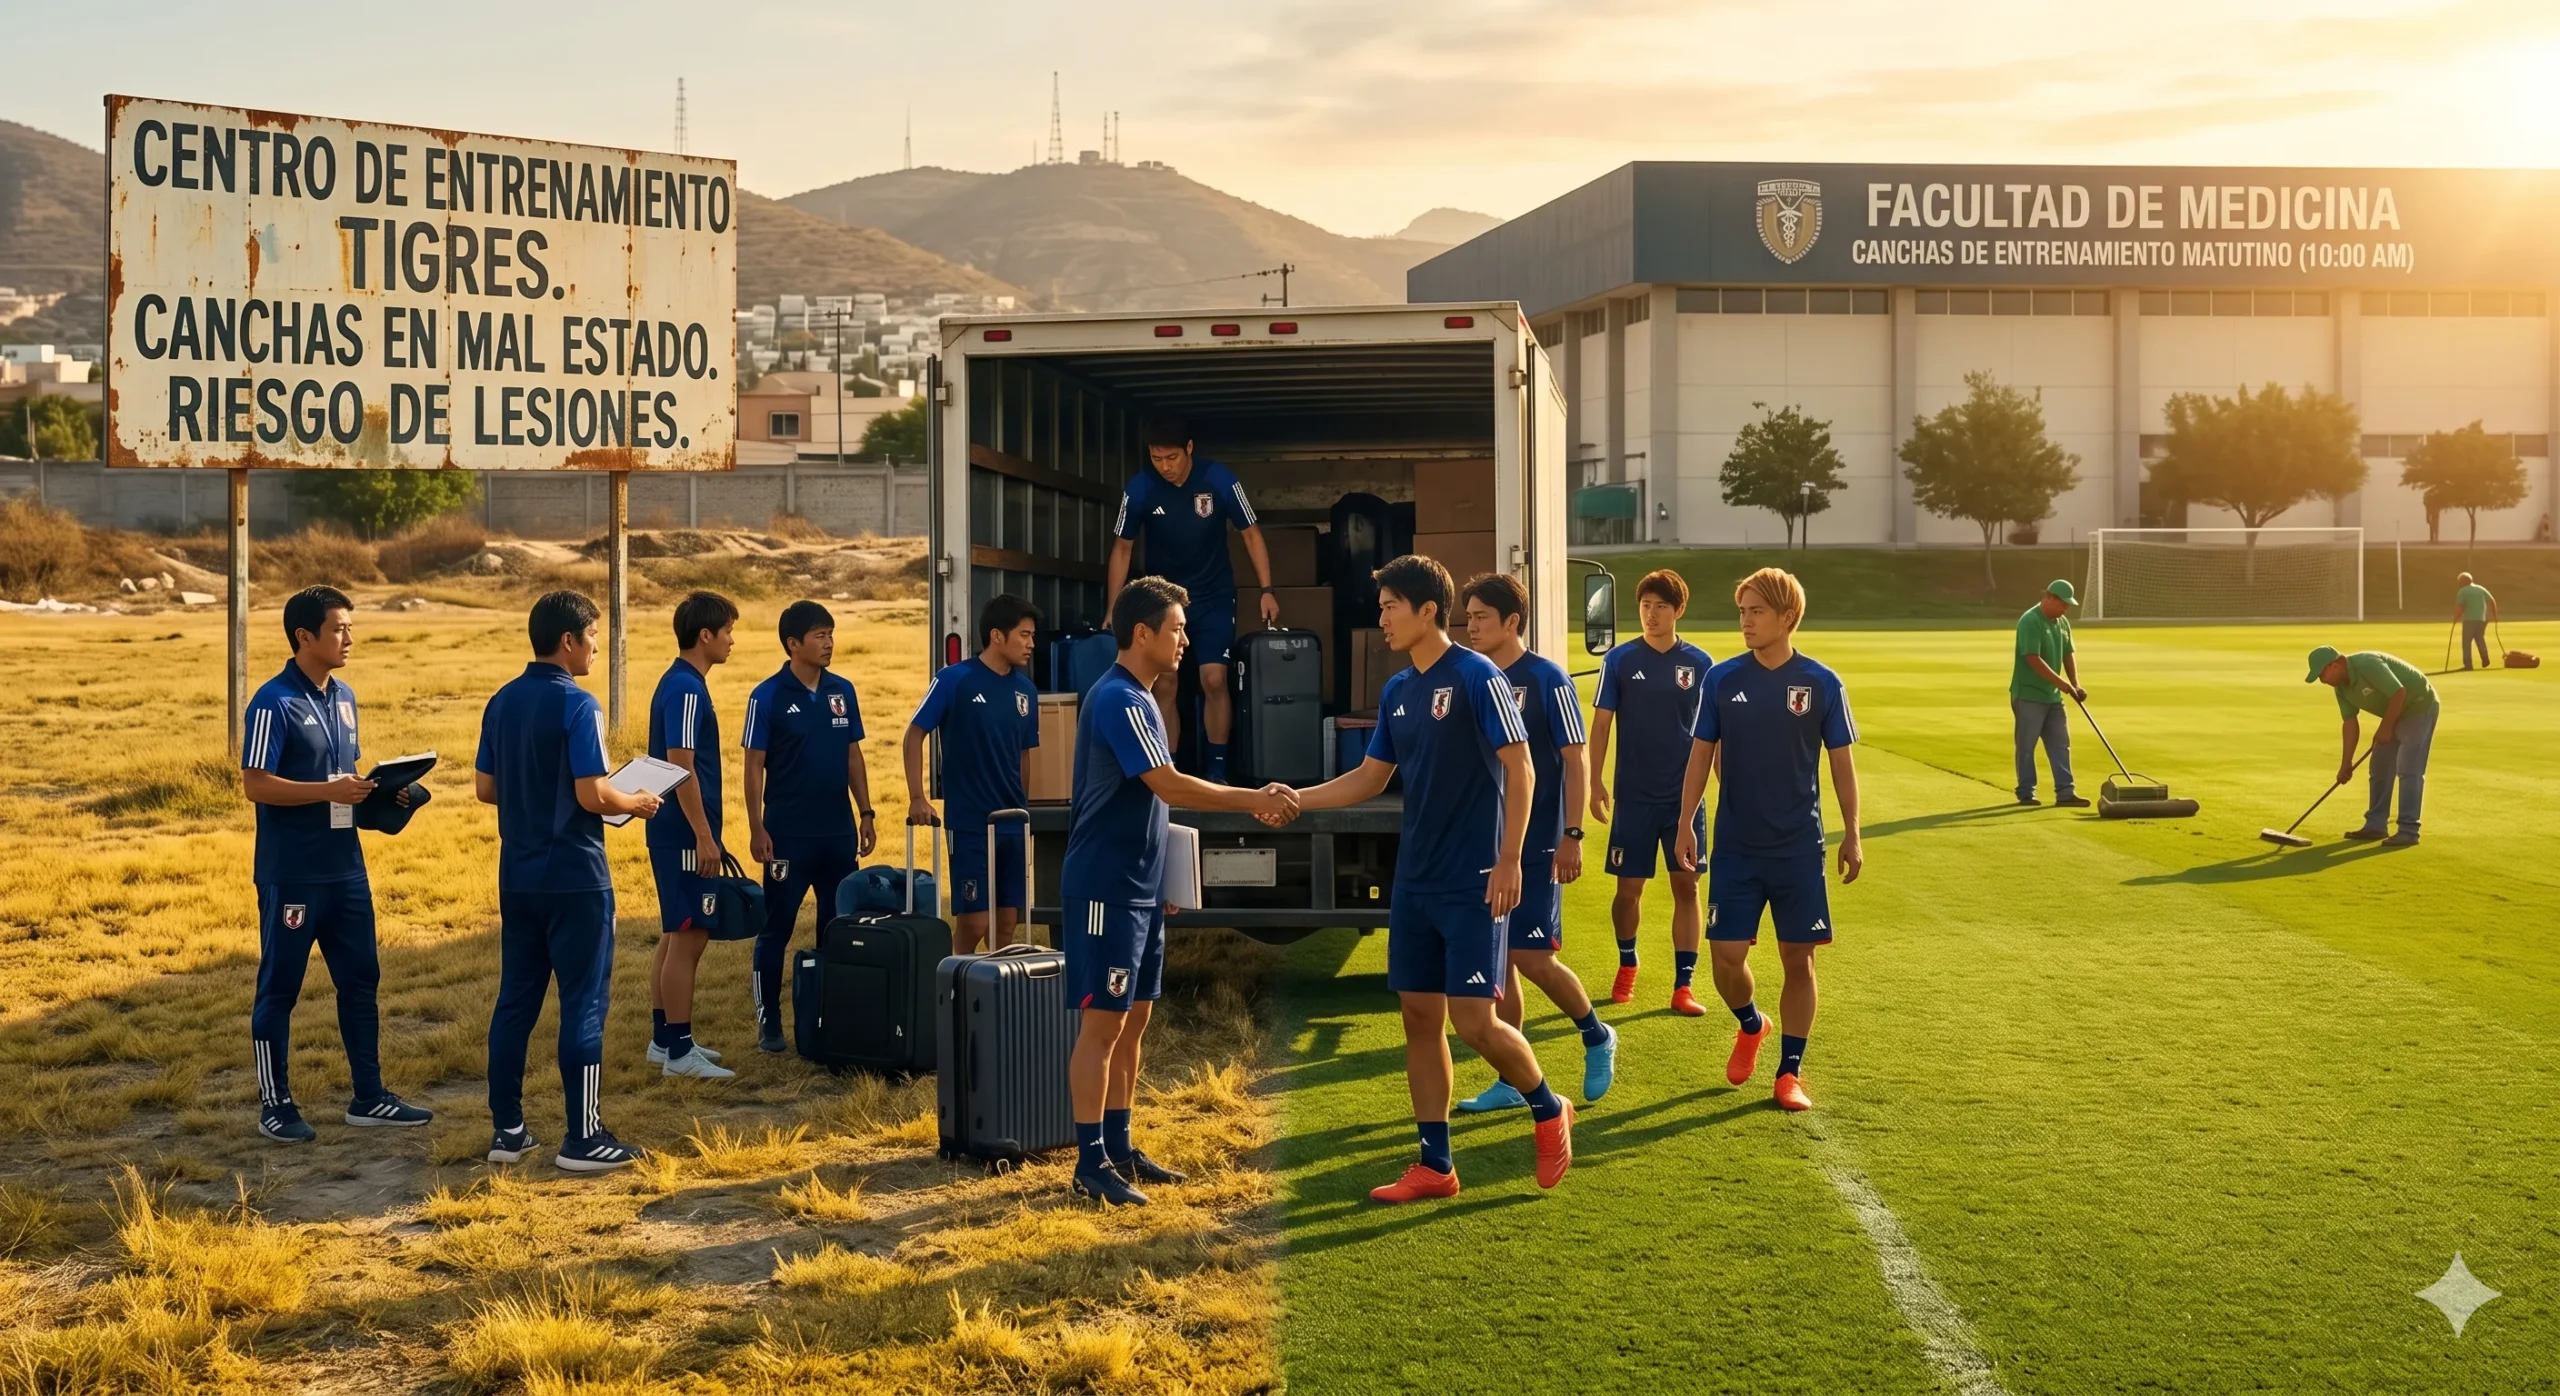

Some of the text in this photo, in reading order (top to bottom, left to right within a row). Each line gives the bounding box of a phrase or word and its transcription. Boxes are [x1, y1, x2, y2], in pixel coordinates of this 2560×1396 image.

[133, 119, 730, 234] CENTRO DE ENTRENAMIENTO
[1868, 182, 2401, 231] FACULTAD DE MEDICINA
[339, 216, 566, 300] TIGRES.
[1852, 239, 2415, 274] CANCHAS DE ENTRENAMIENTO MATUTINO (10:00 AM)
[134, 293, 718, 380] CANCHAS EN MAL ESTADO.
[168, 375, 690, 449] RIESGO DE LESIONES.
